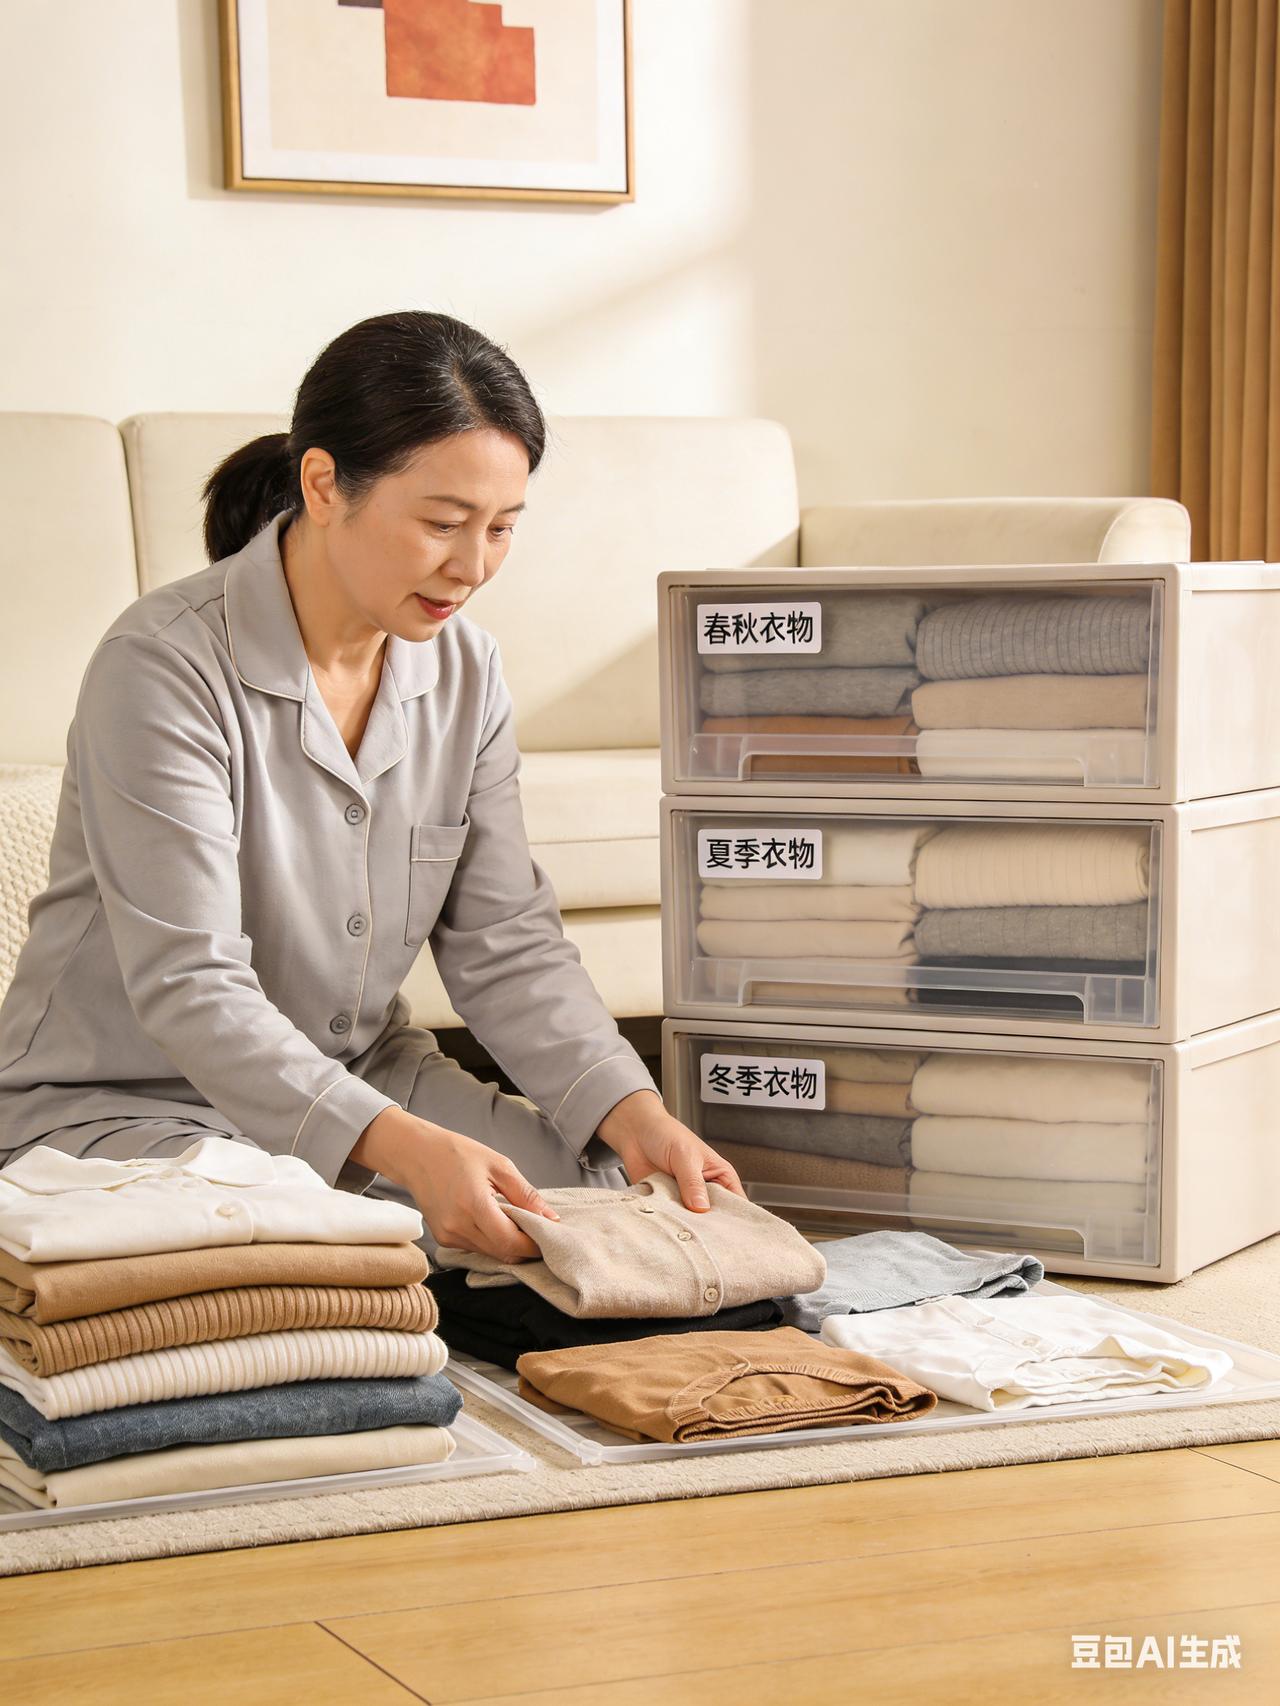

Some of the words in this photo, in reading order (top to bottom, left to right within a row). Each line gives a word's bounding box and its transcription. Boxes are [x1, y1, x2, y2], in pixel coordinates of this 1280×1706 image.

[703, 611, 814, 645] 春秋衣物
[706, 837, 815, 870] 夏季衣物
[707, 1063, 817, 1100] 冬季衣物
